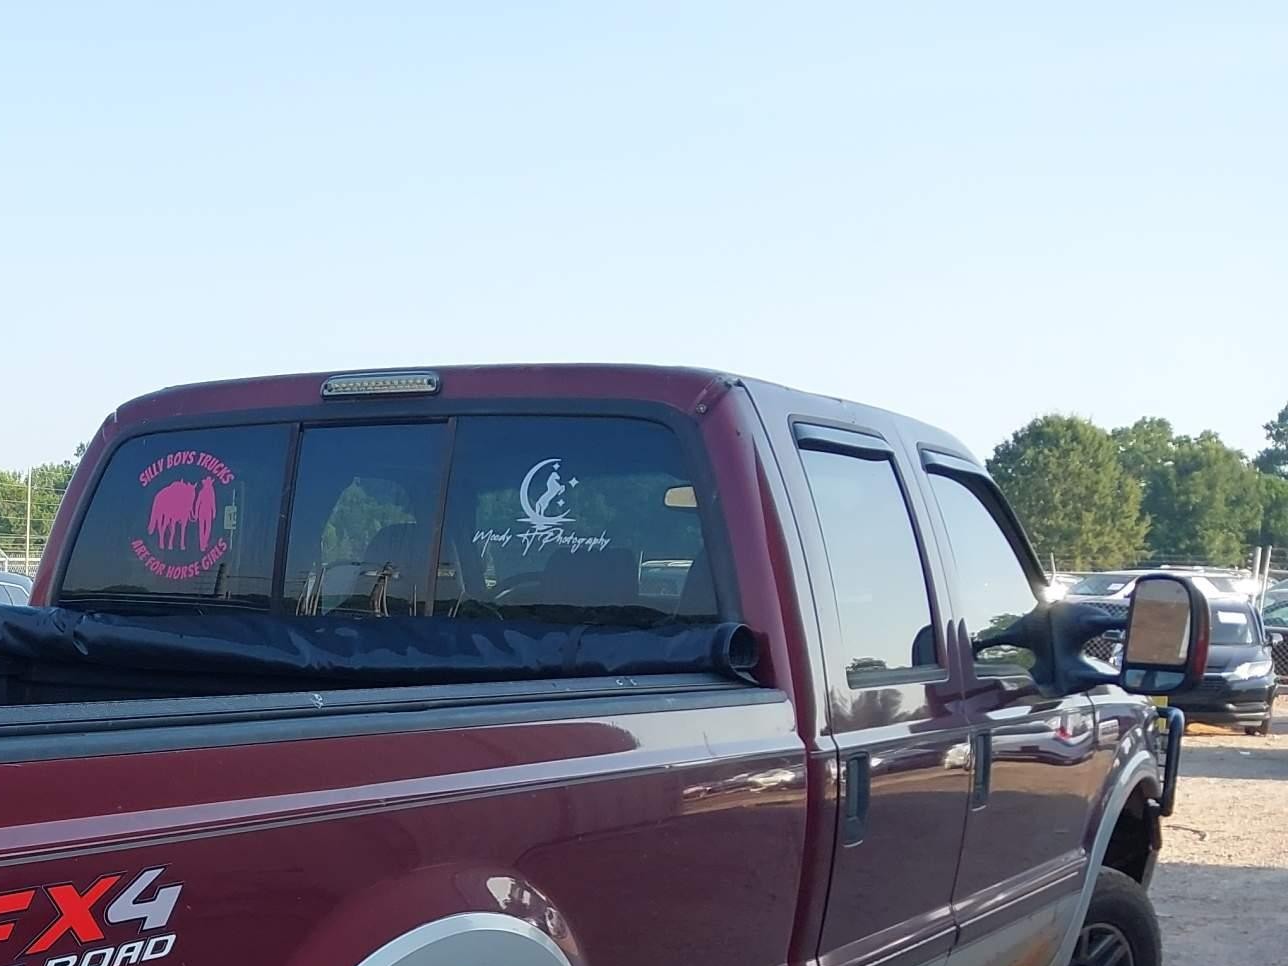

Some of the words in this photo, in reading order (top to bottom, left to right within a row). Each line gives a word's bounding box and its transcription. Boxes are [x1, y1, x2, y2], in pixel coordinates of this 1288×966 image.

[139, 458, 164, 487] SILLY
[166, 451, 196, 469] BOYS
[196, 452, 235, 485] TRUCKS
[538, 527, 611, 554] Photography
[131, 539, 151, 561] ARE
[145, 557, 166, 575] FOR
[166, 561, 200, 580] HORSE
[201, 538, 227, 570] GIRLS
